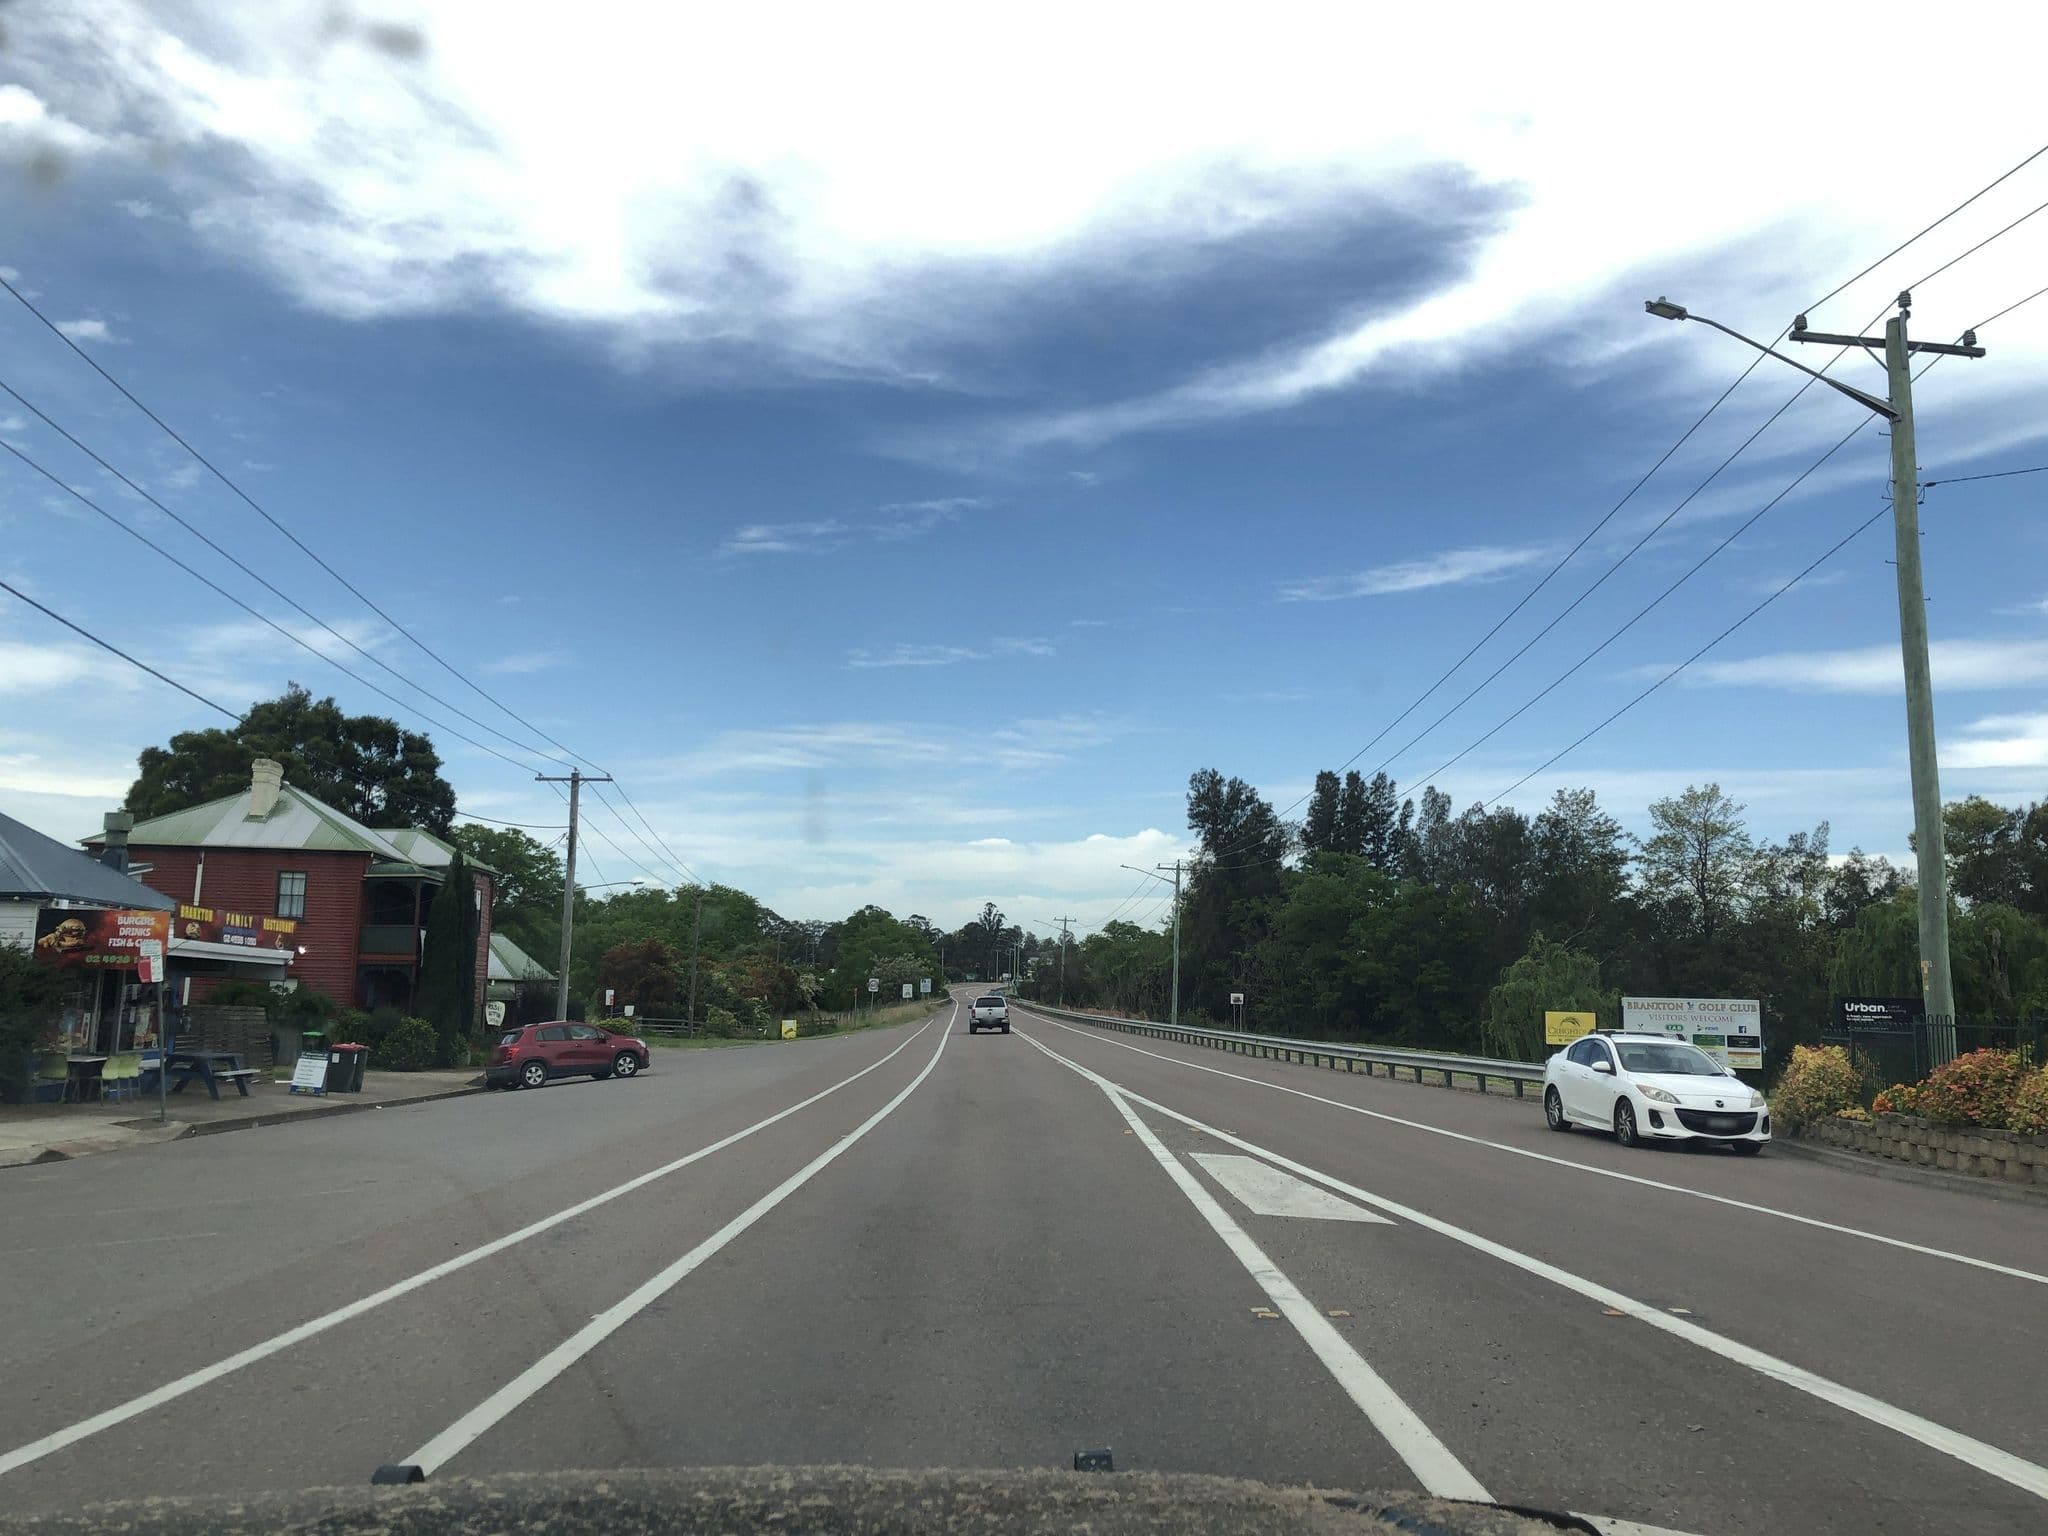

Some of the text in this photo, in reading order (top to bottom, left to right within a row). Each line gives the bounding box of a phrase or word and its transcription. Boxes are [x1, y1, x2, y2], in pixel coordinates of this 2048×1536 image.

[117, 916, 155, 926] BURGERS
[226, 913, 253, 928] FAMILY
[119, 927, 151, 937] DRINKS
[108, 938, 126, 947] FISH
[126, 938, 134, 947] &
[1627, 1001, 1757, 1013] BRANXTON GOLF CLUB
[1649, 1013, 1734, 1023] VISITORS WELCOME
